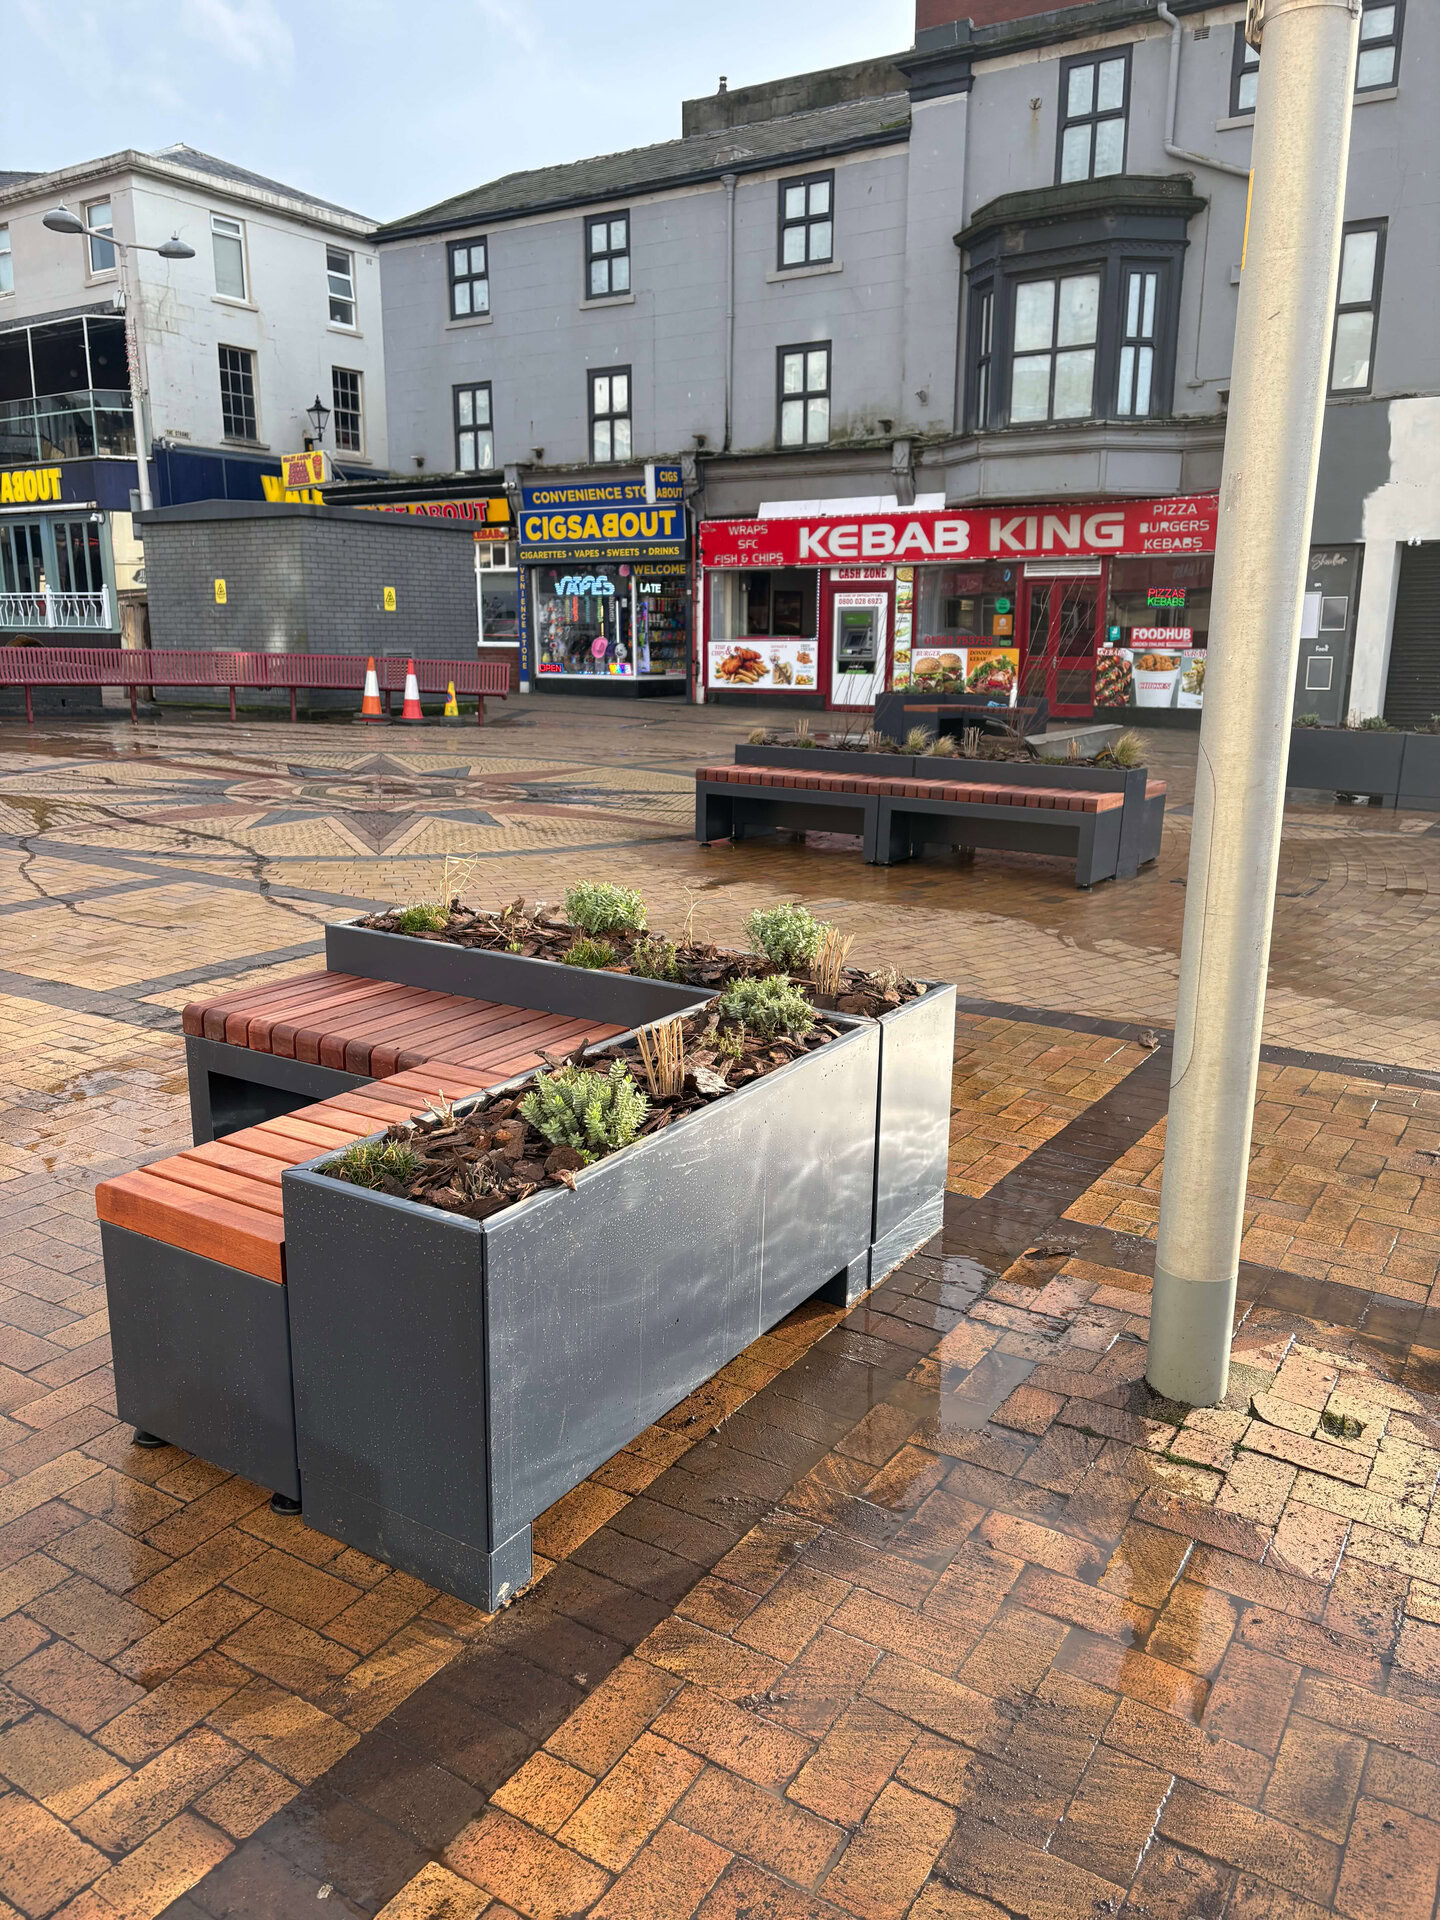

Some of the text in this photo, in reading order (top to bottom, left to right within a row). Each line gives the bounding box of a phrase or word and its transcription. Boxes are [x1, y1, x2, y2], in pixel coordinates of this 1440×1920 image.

[659, 471, 679, 483] CIGS
[532, 487, 622, 504] CONVENIENCE
[656, 487, 683, 498] ABOUT
[1153, 503, 1197, 516] PIZZA
[525, 510, 676, 541] CIGSABOUT
[728, 524, 768, 535] WRAPS
[1139, 520, 1210, 534] BURGERS
[799, 512, 1125, 559] KEBAB KING
[738, 539, 759, 549] SFC
[1144, 536, 1203, 550] KEBABS
[520, 546, 680, 560] CIGARETTES VAPES SWEETS DRINKS
[714, 552, 784, 564] FISH & CHIPS
[633, 564, 687, 575] WELCOME
[838, 567, 887, 579] CASH ZONE
[554, 575, 616, 596] VAPES
[640, 583, 662, 594] LATE
[1147, 588, 1186, 598] PIZZAS
[1147, 597, 1185, 606] KEBABS
[1132, 628, 1191, 640] FOODHUB
[956, 636, 993, 646] 753753
[539, 664, 562, 673] OPEN
